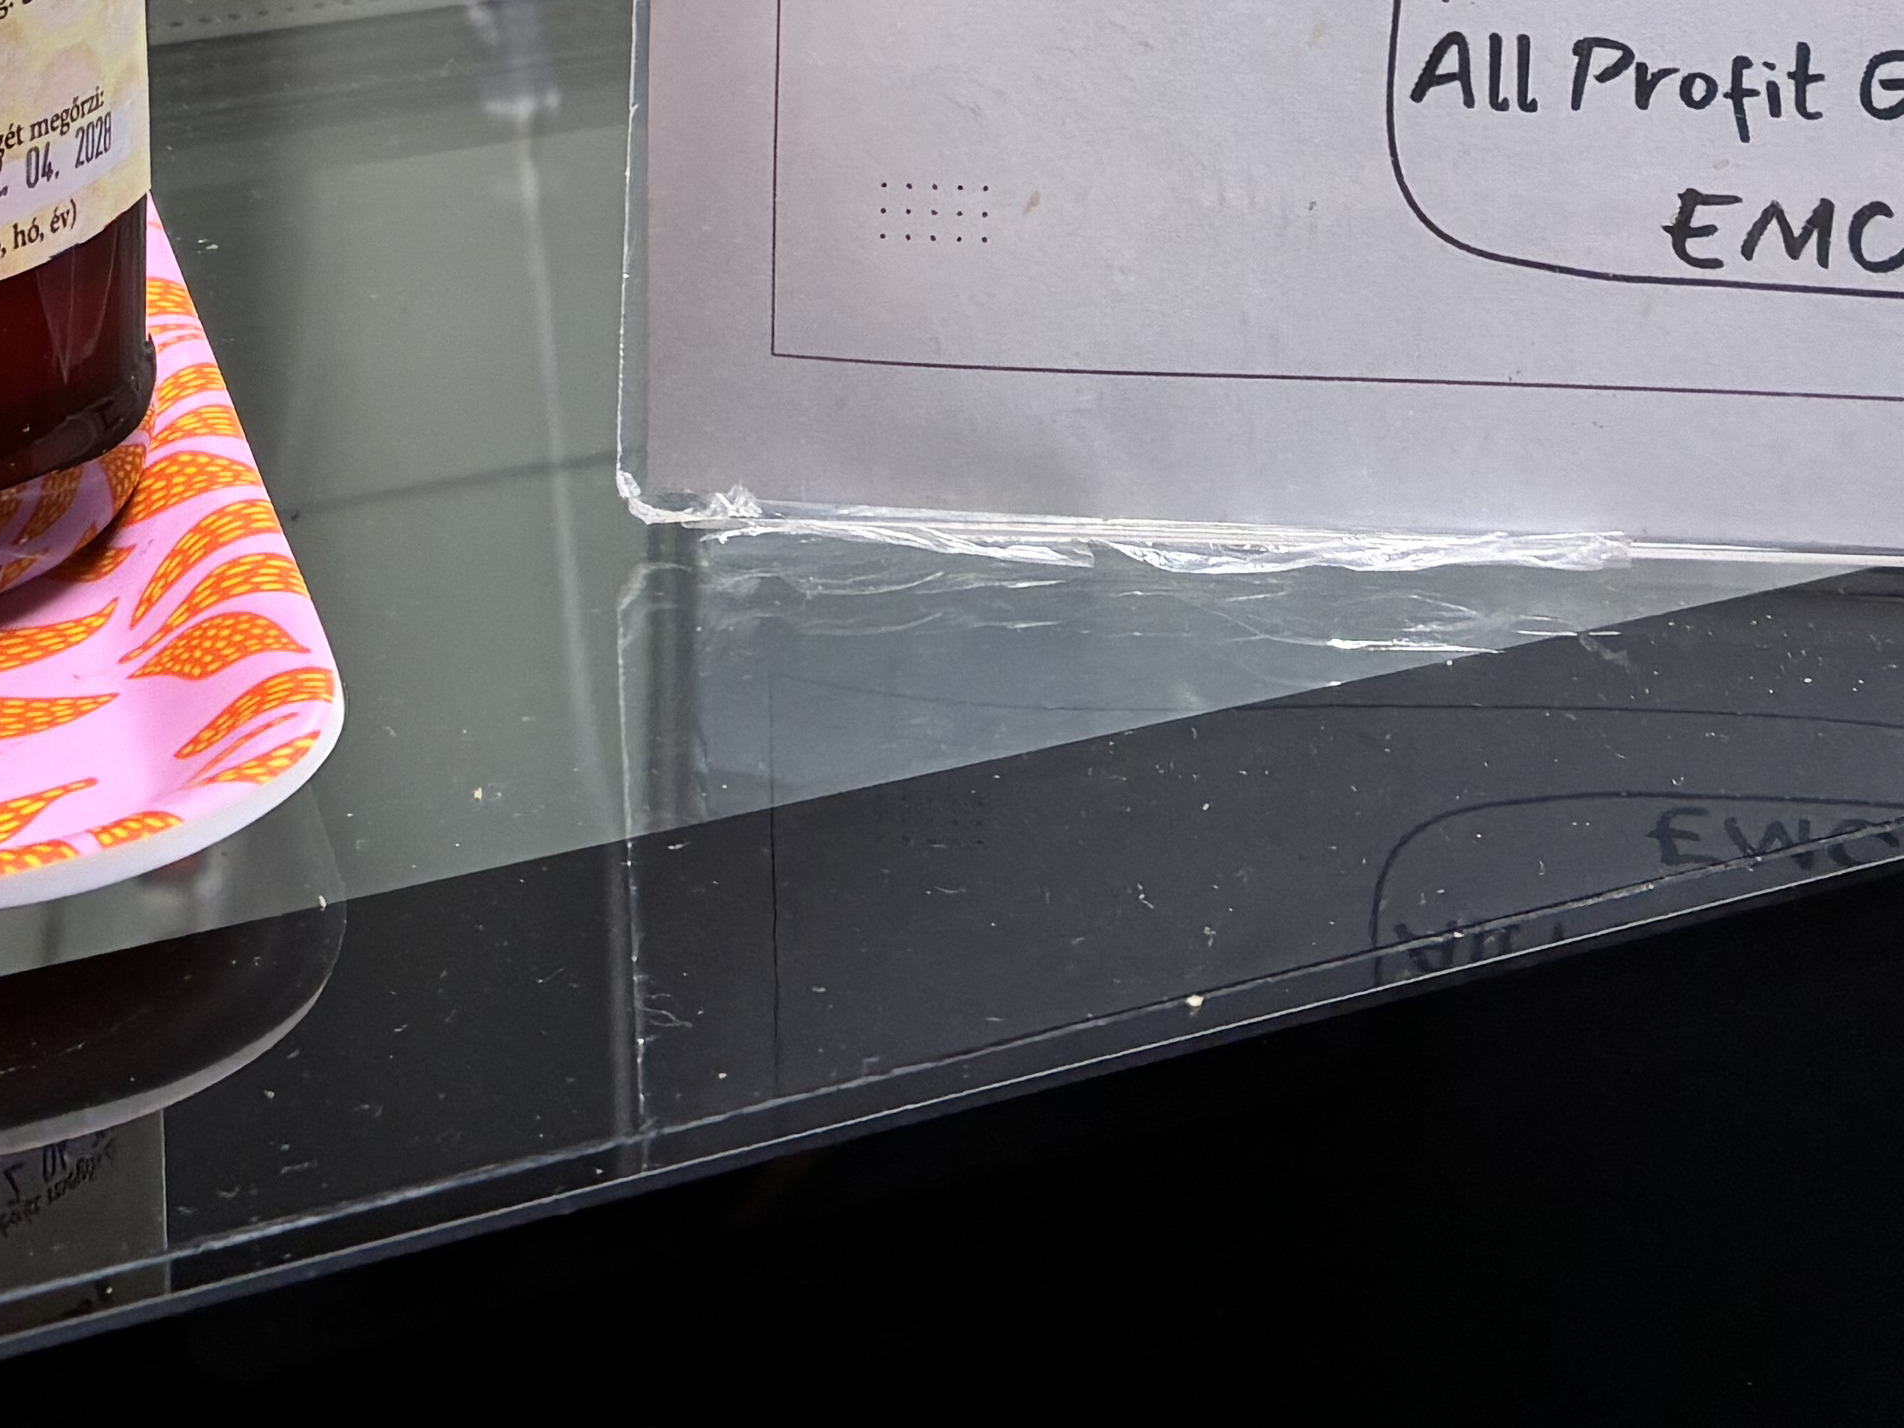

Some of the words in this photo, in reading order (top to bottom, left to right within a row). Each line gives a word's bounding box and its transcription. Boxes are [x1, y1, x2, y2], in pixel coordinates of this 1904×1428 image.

[29, 85, 105, 142] megőrzi:
[1410, 30, 1538, 114] All
[1571, 36, 1826, 143] Profit
[74, 111, 112, 169] 2028
[12, 216, 45, 250] hó,
[49, 198, 78, 234] év)
